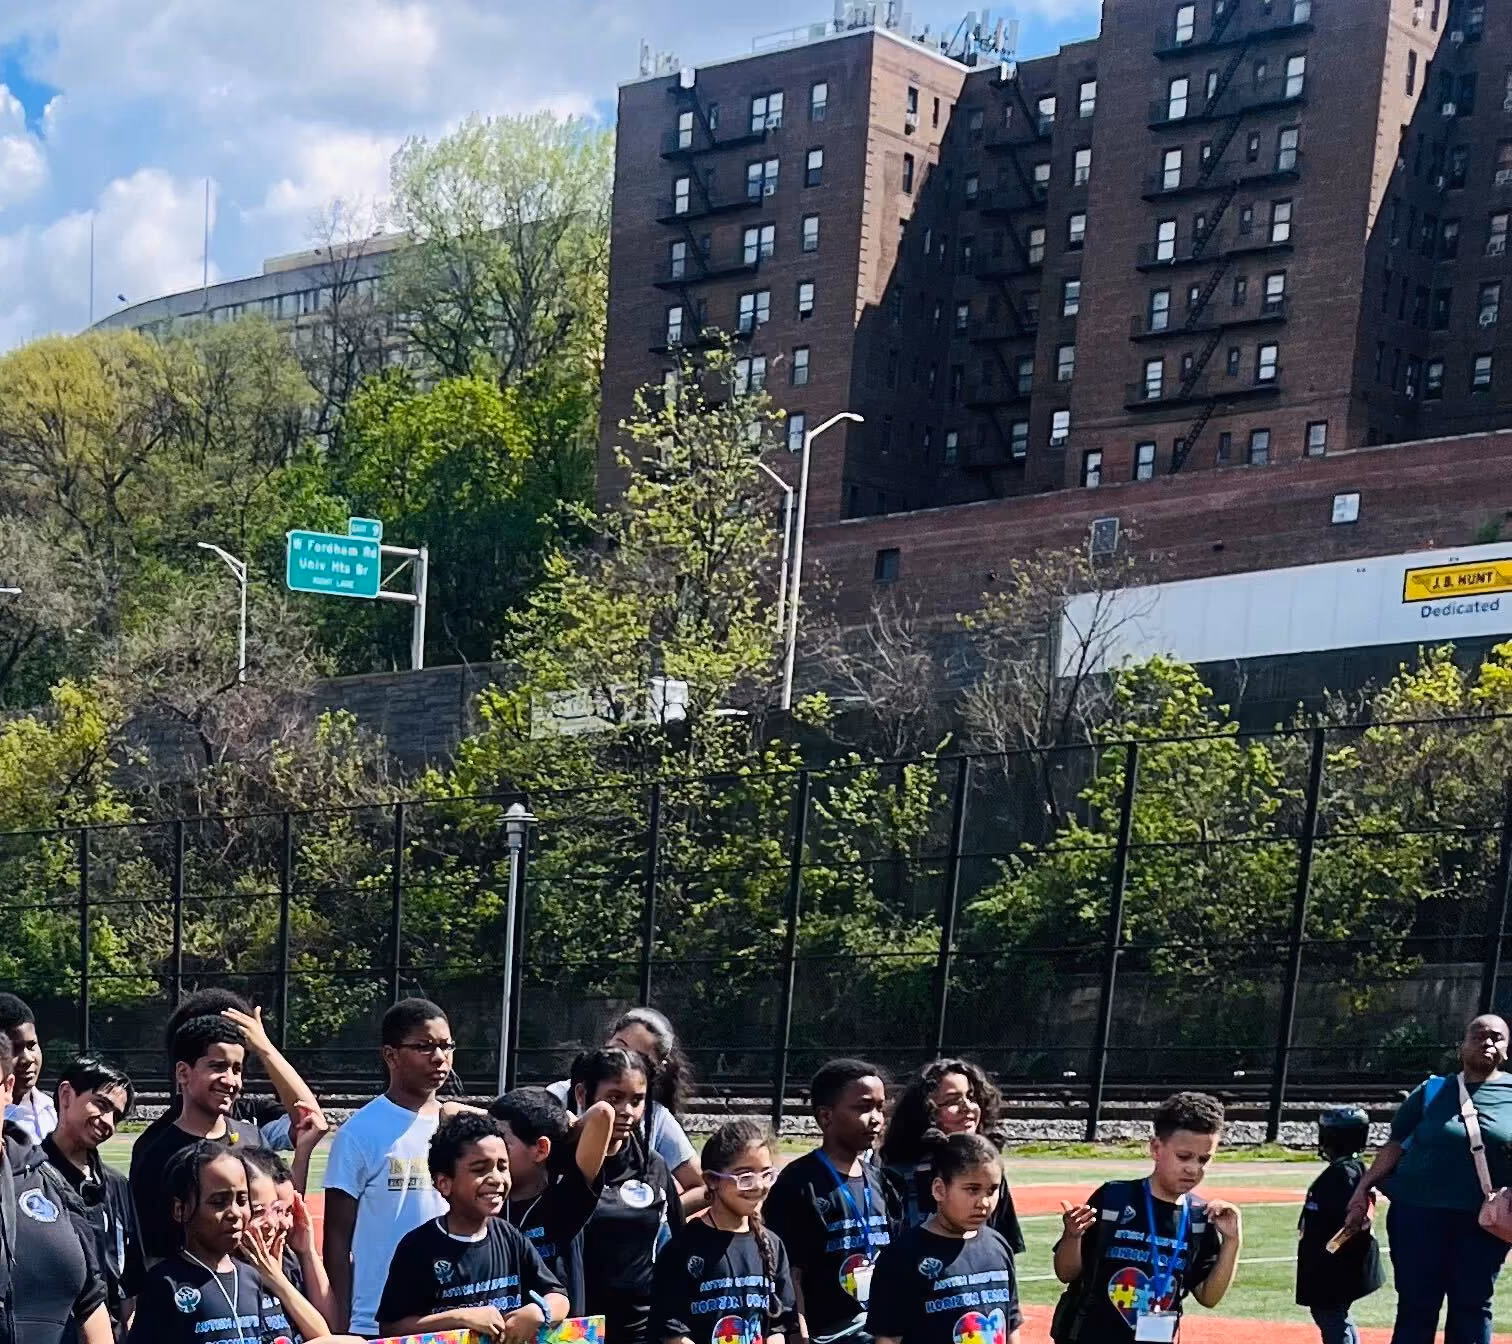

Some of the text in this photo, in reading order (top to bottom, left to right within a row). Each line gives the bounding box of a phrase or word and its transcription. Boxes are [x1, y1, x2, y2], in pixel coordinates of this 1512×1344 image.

[293, 538, 377, 559] W Fordham Rd
[299, 557, 368, 576] Univ Hts Br
[1458, 571, 1493, 585] HUNT
[1420, 599, 1500, 618] Dedicated
